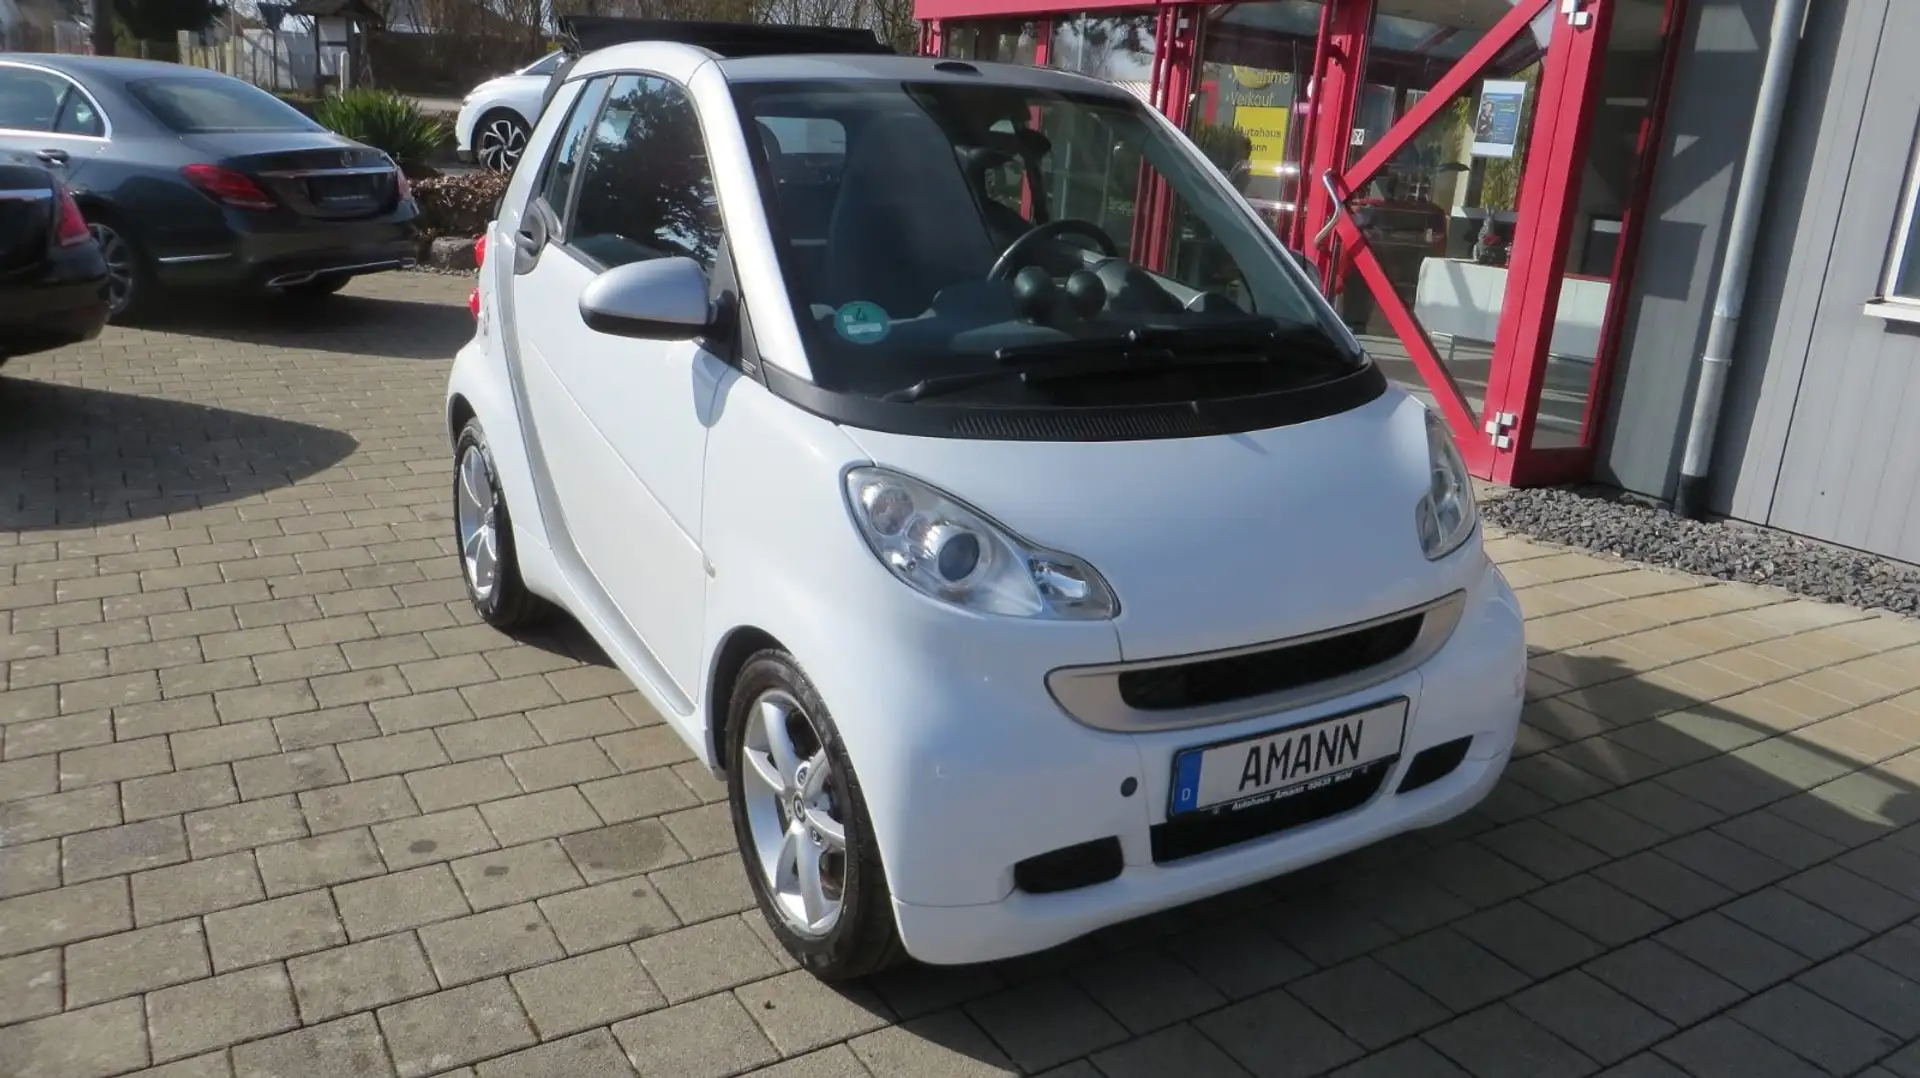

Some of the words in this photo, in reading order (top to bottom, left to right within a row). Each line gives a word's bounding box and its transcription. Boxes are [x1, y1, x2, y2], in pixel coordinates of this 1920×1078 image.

[1238, 719, 1363, 792] AMANN
[1181, 787, 1191, 802] D
[1231, 795, 1271, 812] Autohaus
[1274, 785, 1305, 800] Amann
